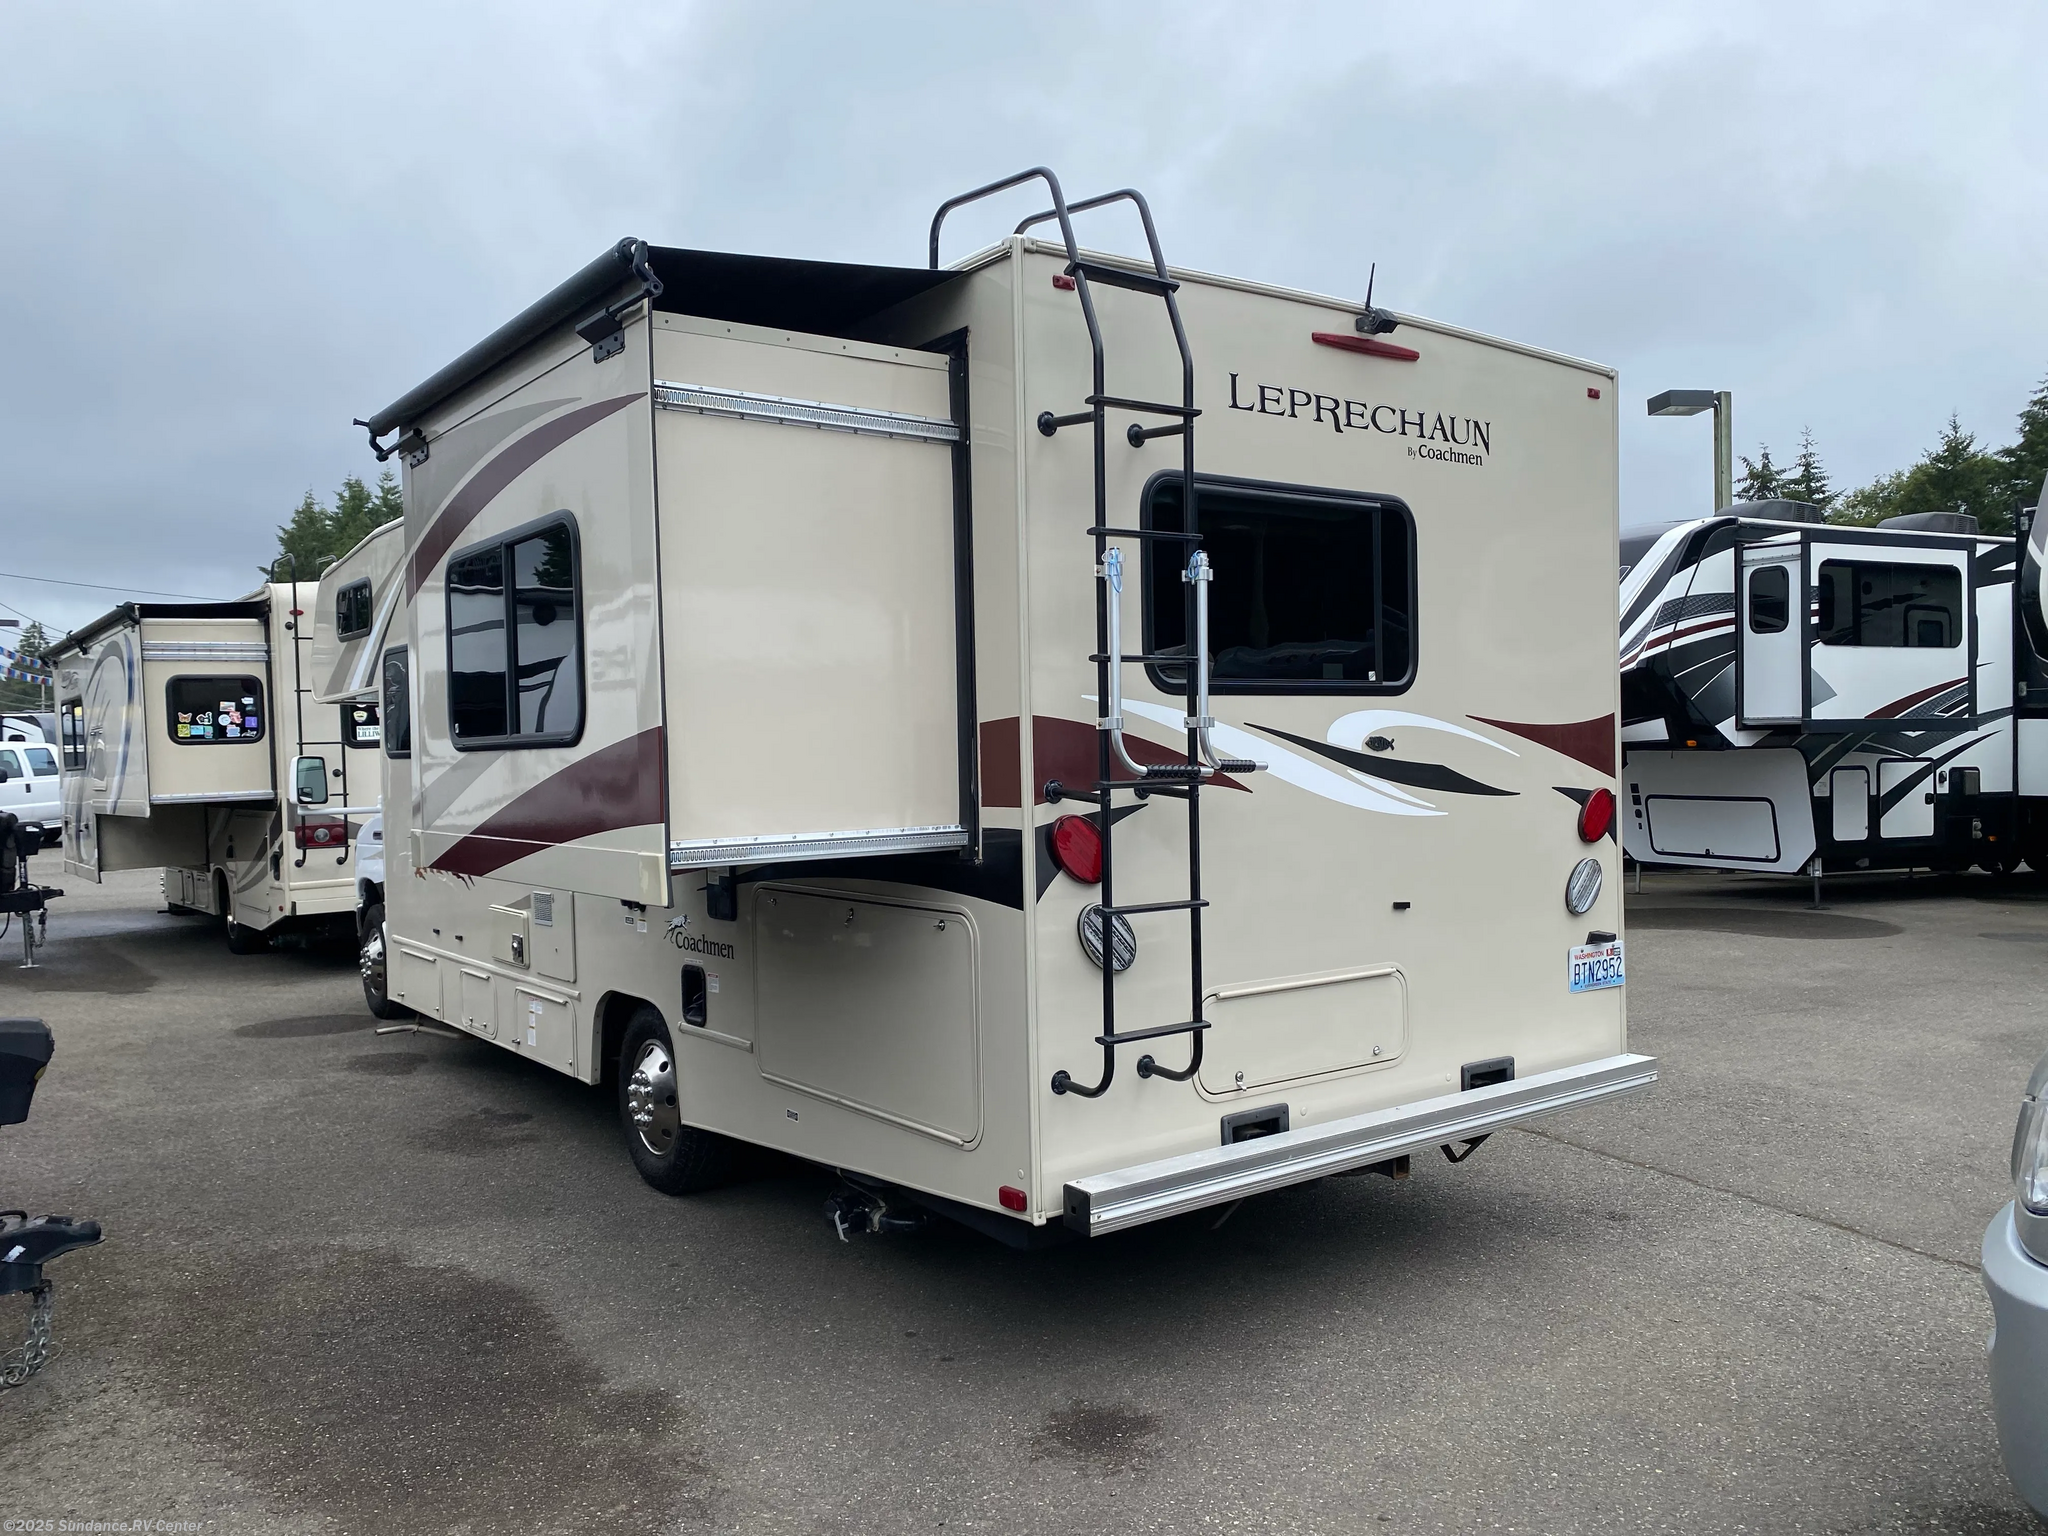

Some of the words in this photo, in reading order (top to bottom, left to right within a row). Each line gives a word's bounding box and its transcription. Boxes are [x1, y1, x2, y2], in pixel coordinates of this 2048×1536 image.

[1228, 371, 1491, 456] LEPRECHAUN
[1407, 446, 1418, 460] By
[1418, 444, 1483, 466] Coachmen
[675, 931, 735, 960] Coachmen
[1574, 951, 1604, 960] WASHINGTON
[1574, 956, 1623, 986] BTN2952
